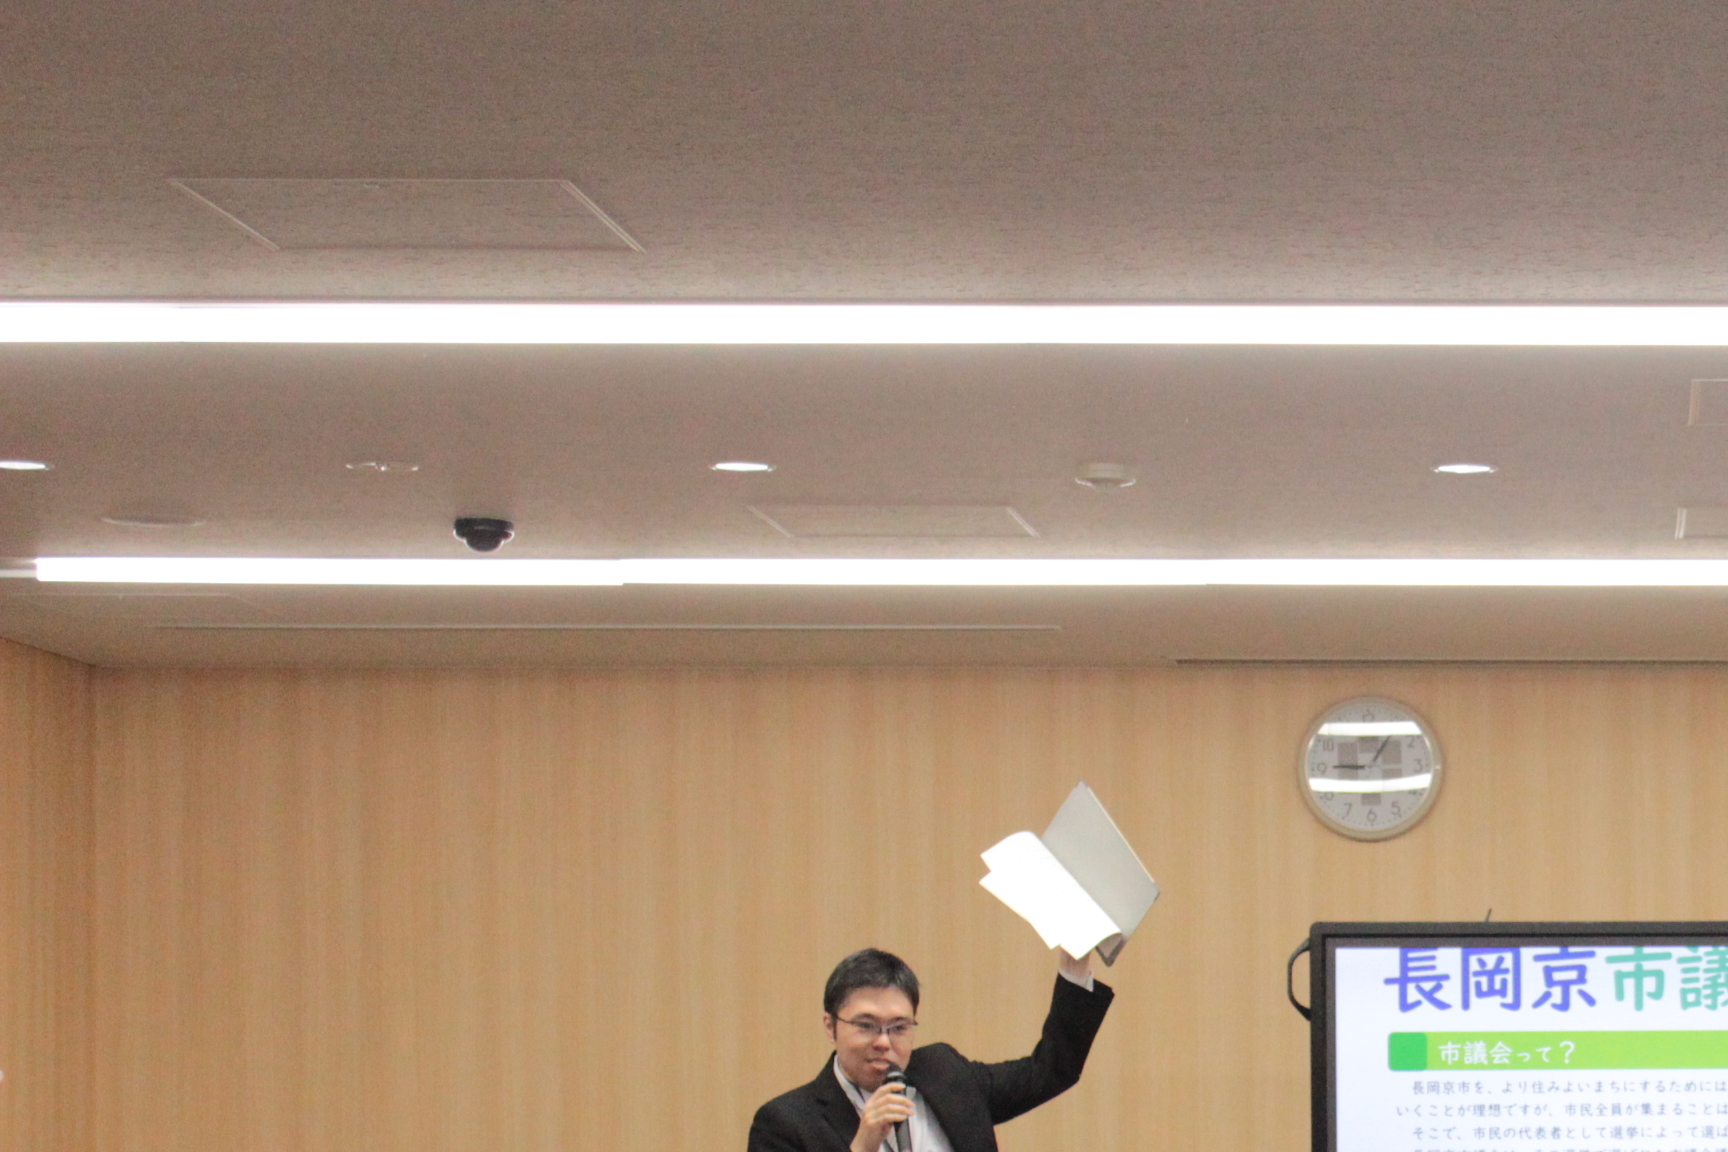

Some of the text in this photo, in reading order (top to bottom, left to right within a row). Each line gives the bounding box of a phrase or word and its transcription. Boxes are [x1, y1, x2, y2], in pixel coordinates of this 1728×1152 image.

[1438, 1039, 1577, 1066] 市議会って？
